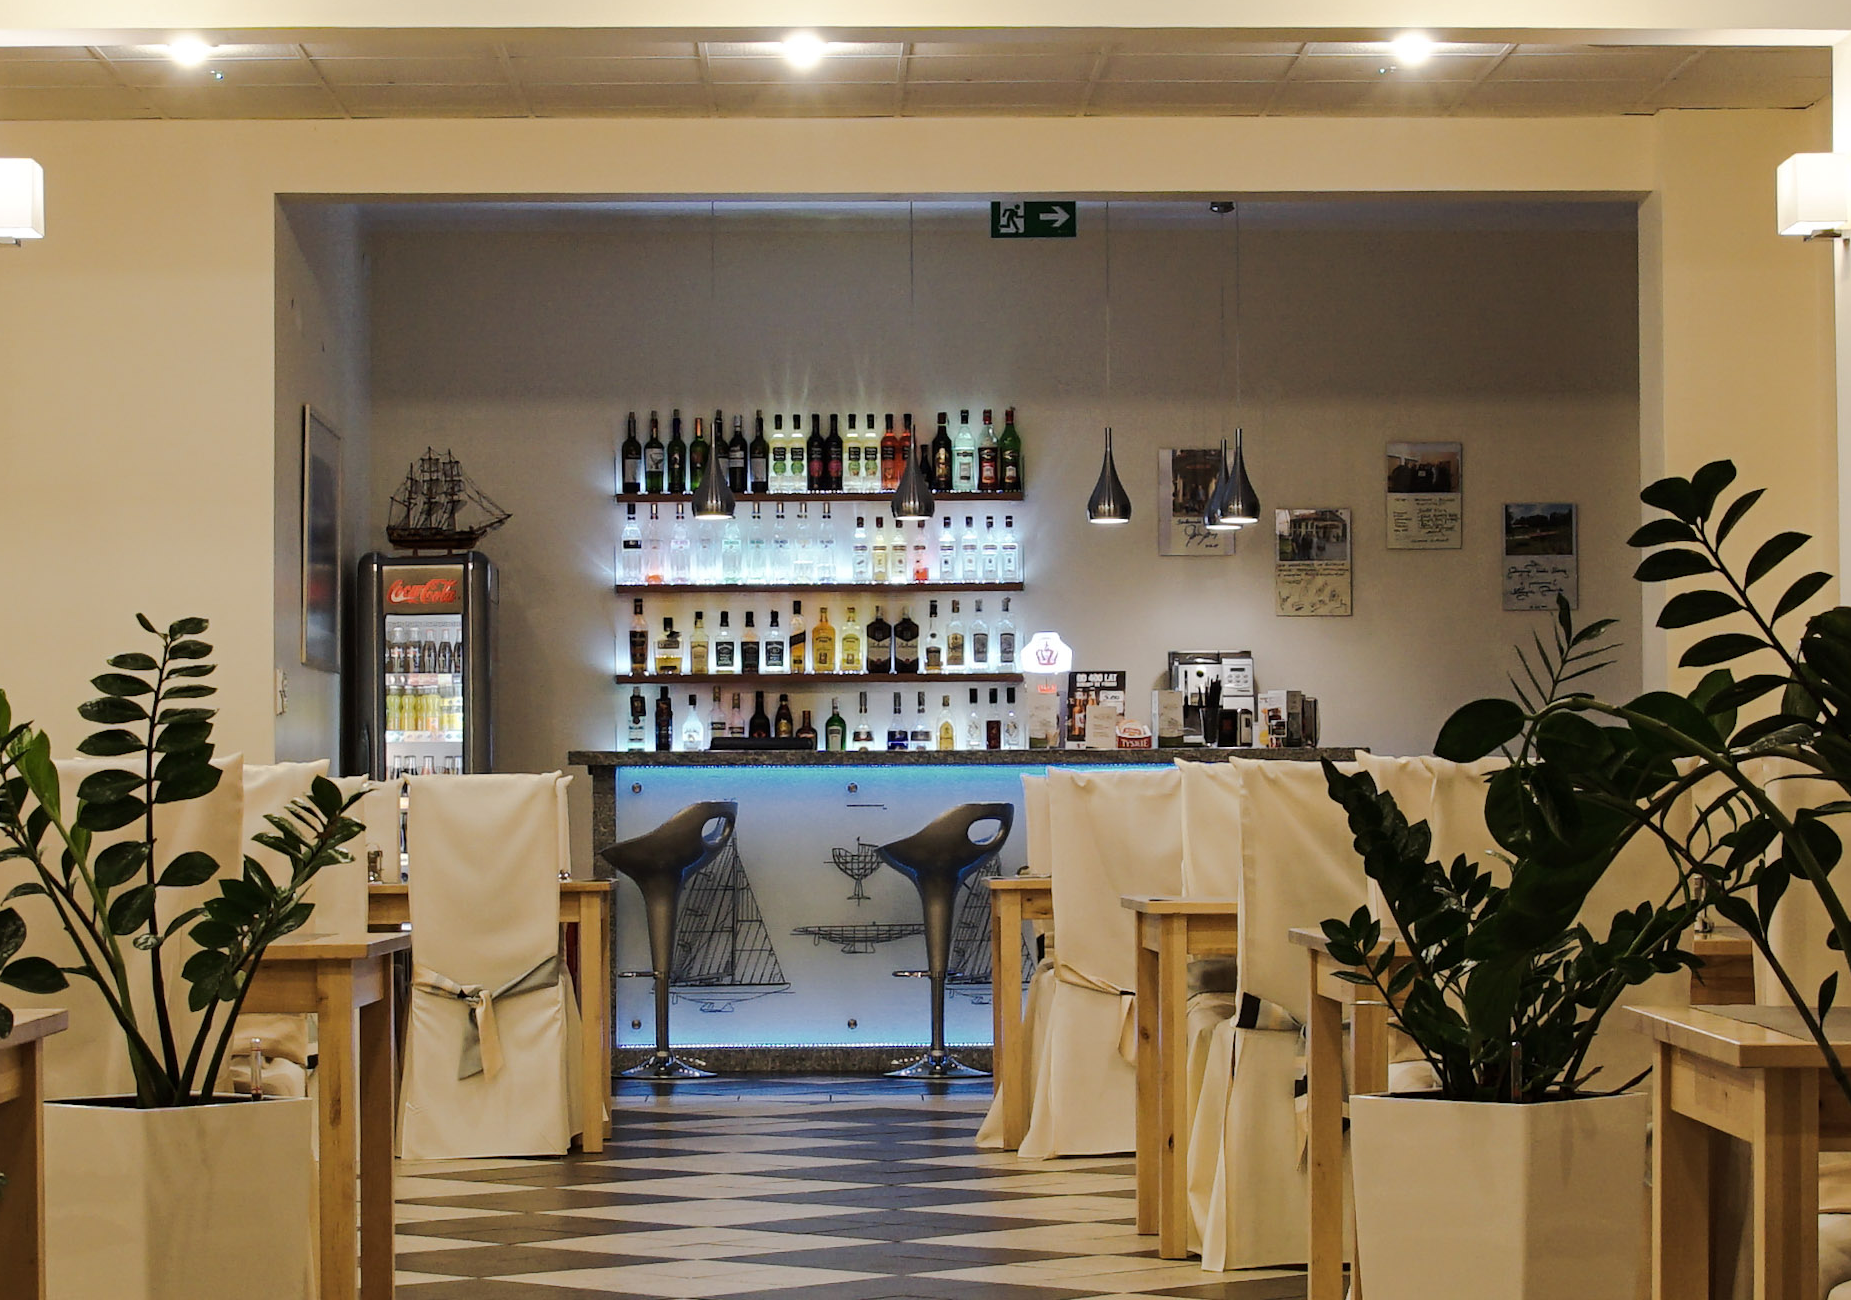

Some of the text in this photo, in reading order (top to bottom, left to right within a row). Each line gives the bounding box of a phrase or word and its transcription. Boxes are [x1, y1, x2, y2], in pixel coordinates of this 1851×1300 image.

[387, 579, 457, 604] Coca-Cola
[1104, 673, 1118, 681] LAT
[1121, 739, 1149, 748] TYSKIE
